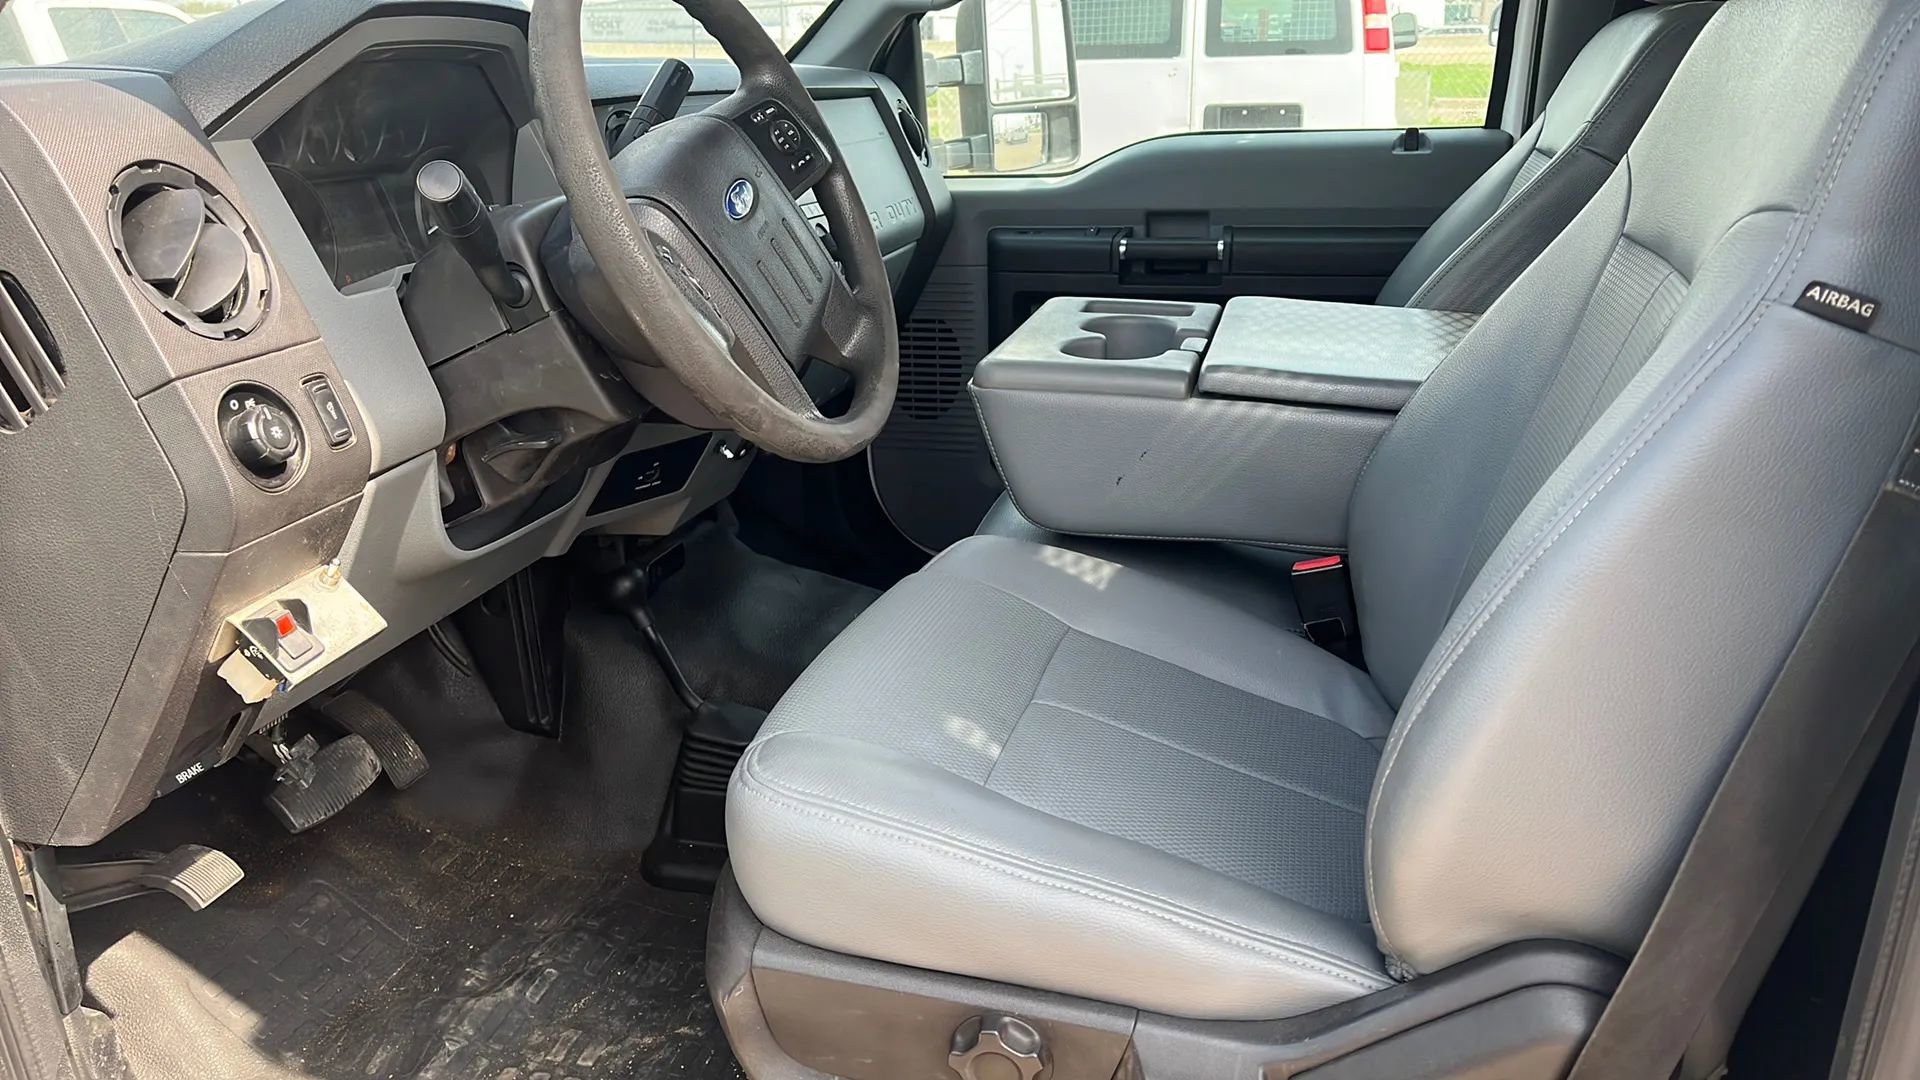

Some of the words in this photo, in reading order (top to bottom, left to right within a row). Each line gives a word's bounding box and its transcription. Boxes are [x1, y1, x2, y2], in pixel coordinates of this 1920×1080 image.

[885, 196, 917, 221] DUTY
[1806, 285, 1875, 318] AIRBAG
[175, 762, 205, 784] BRAKE
